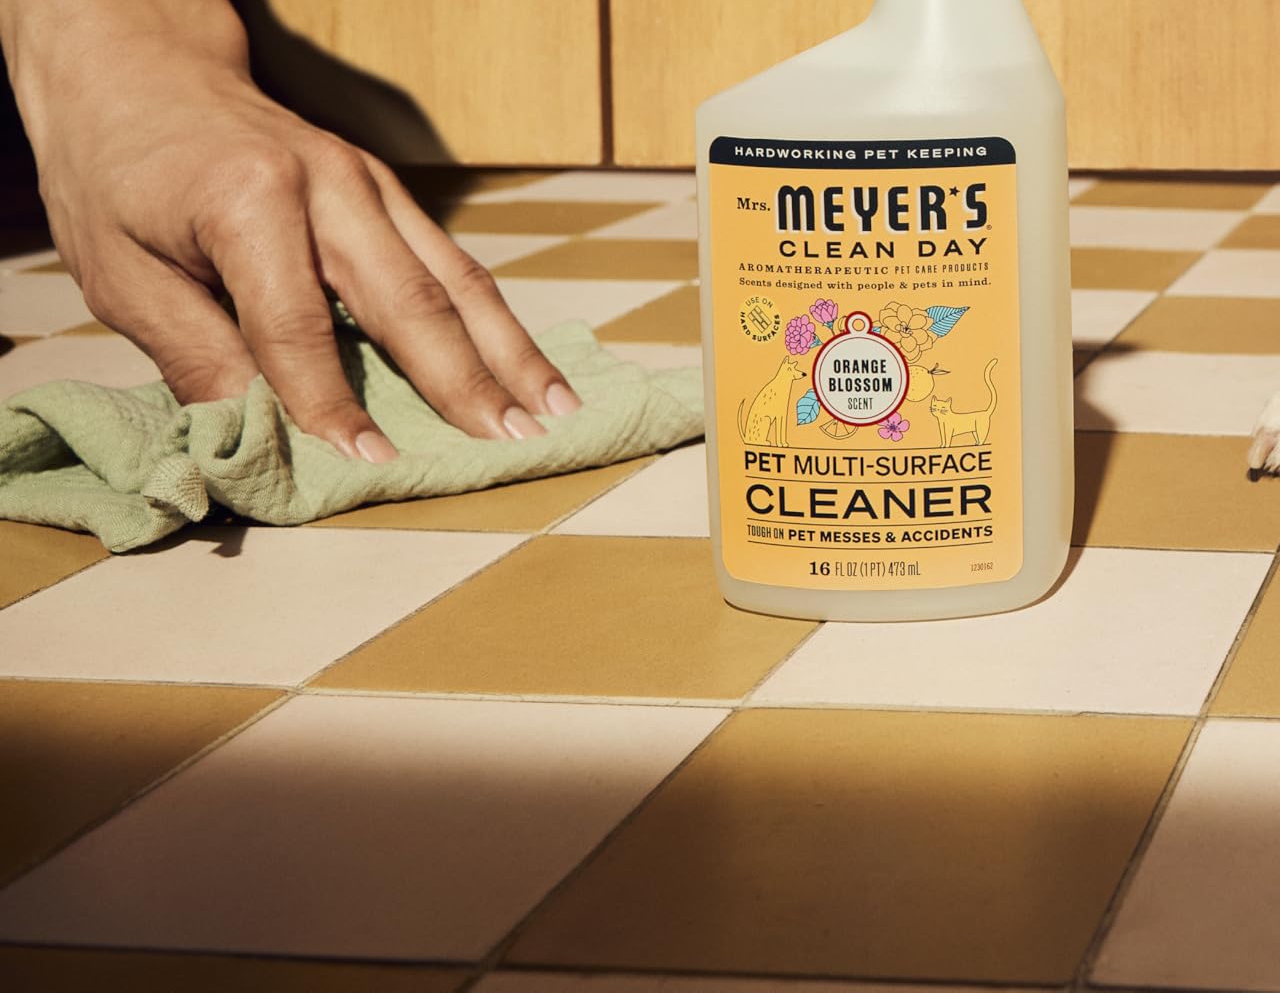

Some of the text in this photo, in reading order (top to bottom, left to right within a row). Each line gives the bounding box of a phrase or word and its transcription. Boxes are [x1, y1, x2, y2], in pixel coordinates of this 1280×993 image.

[735, 146, 988, 160] HARDWORKING PET KEEPING
[737, 197, 771, 211] Mrs.
[779, 238, 988, 258] CLEAN DAY
[739, 262, 989, 275] AROMATHERAPEUTIC PET CARE PRODUCTS
[739, 278, 991, 291] Scents designed with people & pets in mind.
[745, 297, 773, 308] USE ON
[833, 359, 887, 374] ORANGE
[829, 377, 893, 392] BLOSSOM
[848, 397, 873, 410] SCENT
[744, 450, 992, 476] PET MULTI-SURFACE
[746, 484, 992, 519] CLEANER
[747, 524, 993, 543] TOUGH ON PET MESSES & ACCIDENTS
[809, 561, 830, 576] 16
[835, 562, 845, 576] FL
[847, 562, 857, 577] OZ
[888, 562, 905, 576] 473
[907, 562, 921, 576] mL
